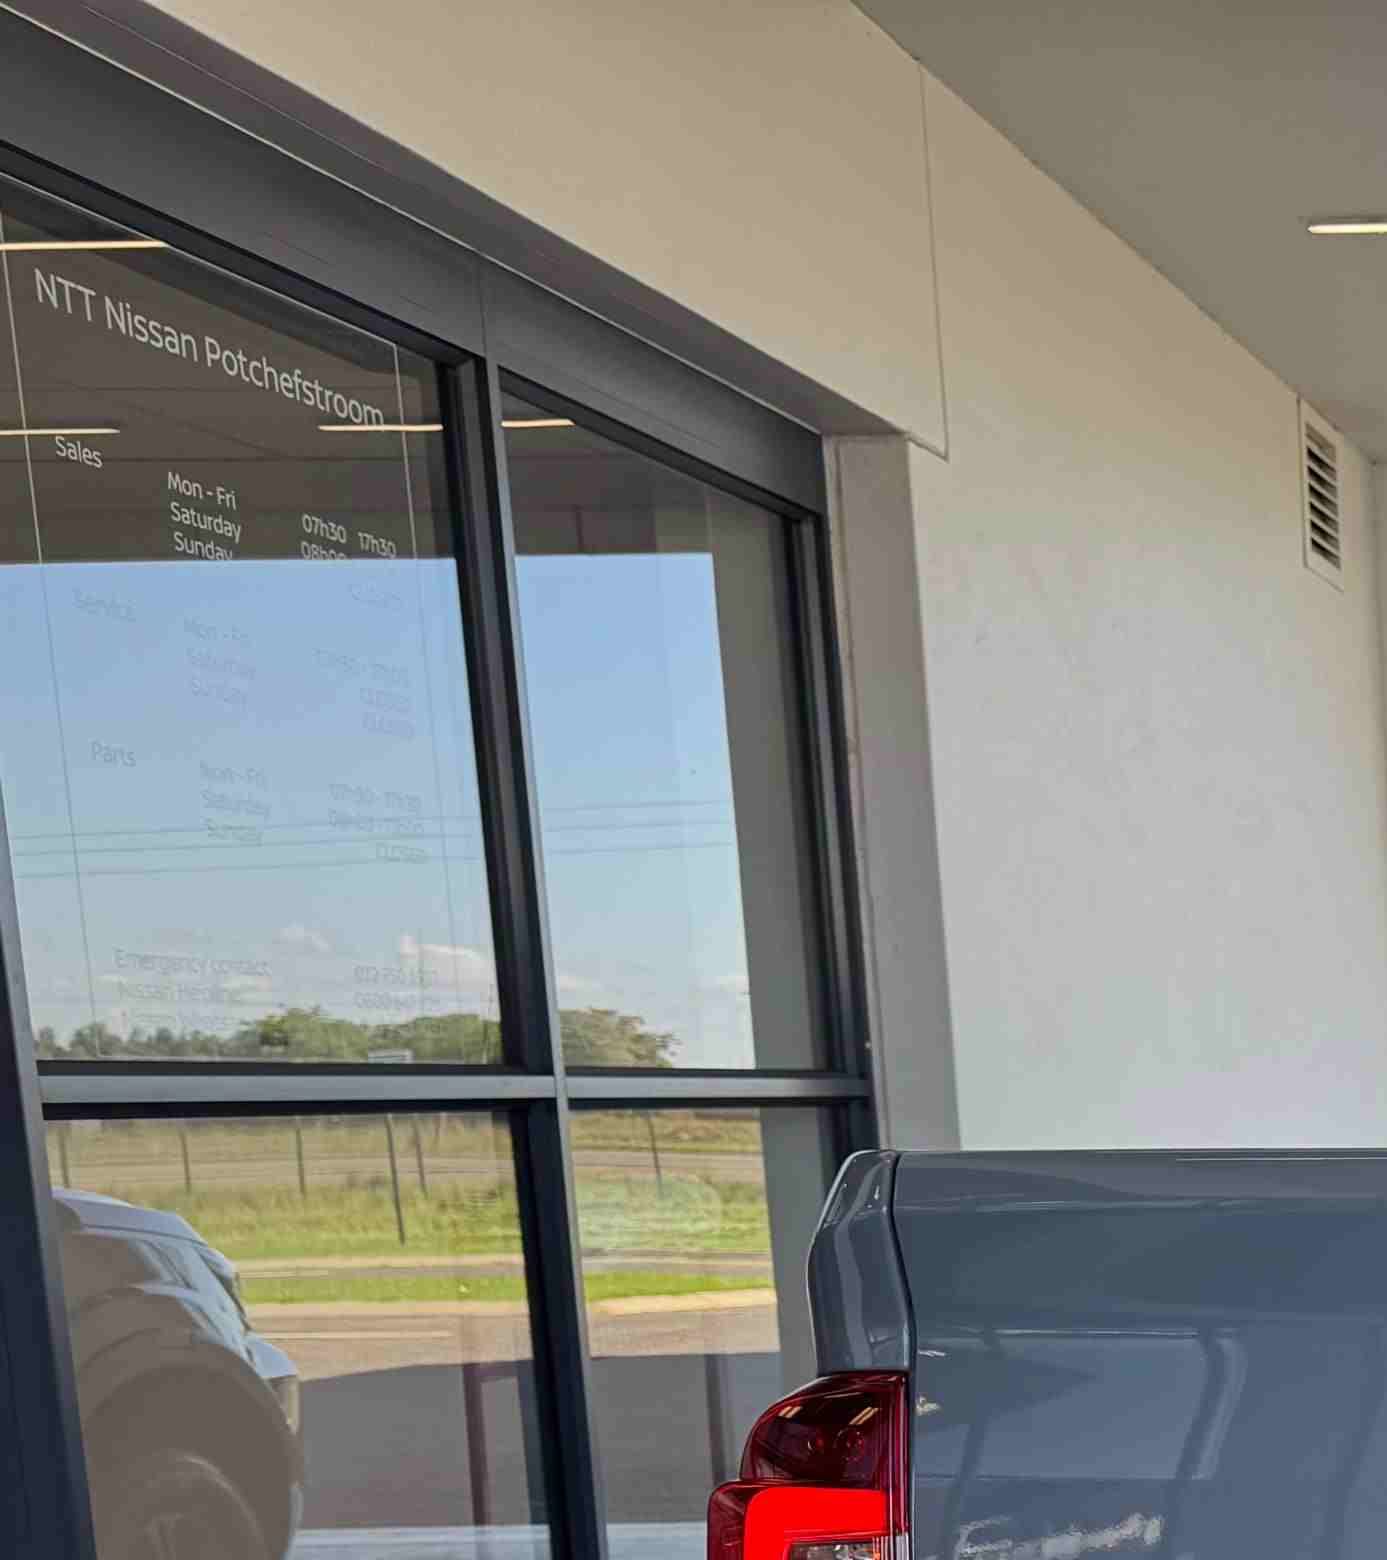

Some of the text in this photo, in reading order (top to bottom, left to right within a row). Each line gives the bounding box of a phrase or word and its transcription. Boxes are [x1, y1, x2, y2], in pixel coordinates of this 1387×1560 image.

[33, 267, 385, 431] NTT Nissan Potchefstroom
[55, 435, 103, 468] Sales
[167, 471, 203, 500] Mon
[216, 486, 237, 511] Fri
[170, 501, 241, 544] Saturday
[301, 513, 348, 544] 07h30
[173, 531, 233, 561] Sunday
